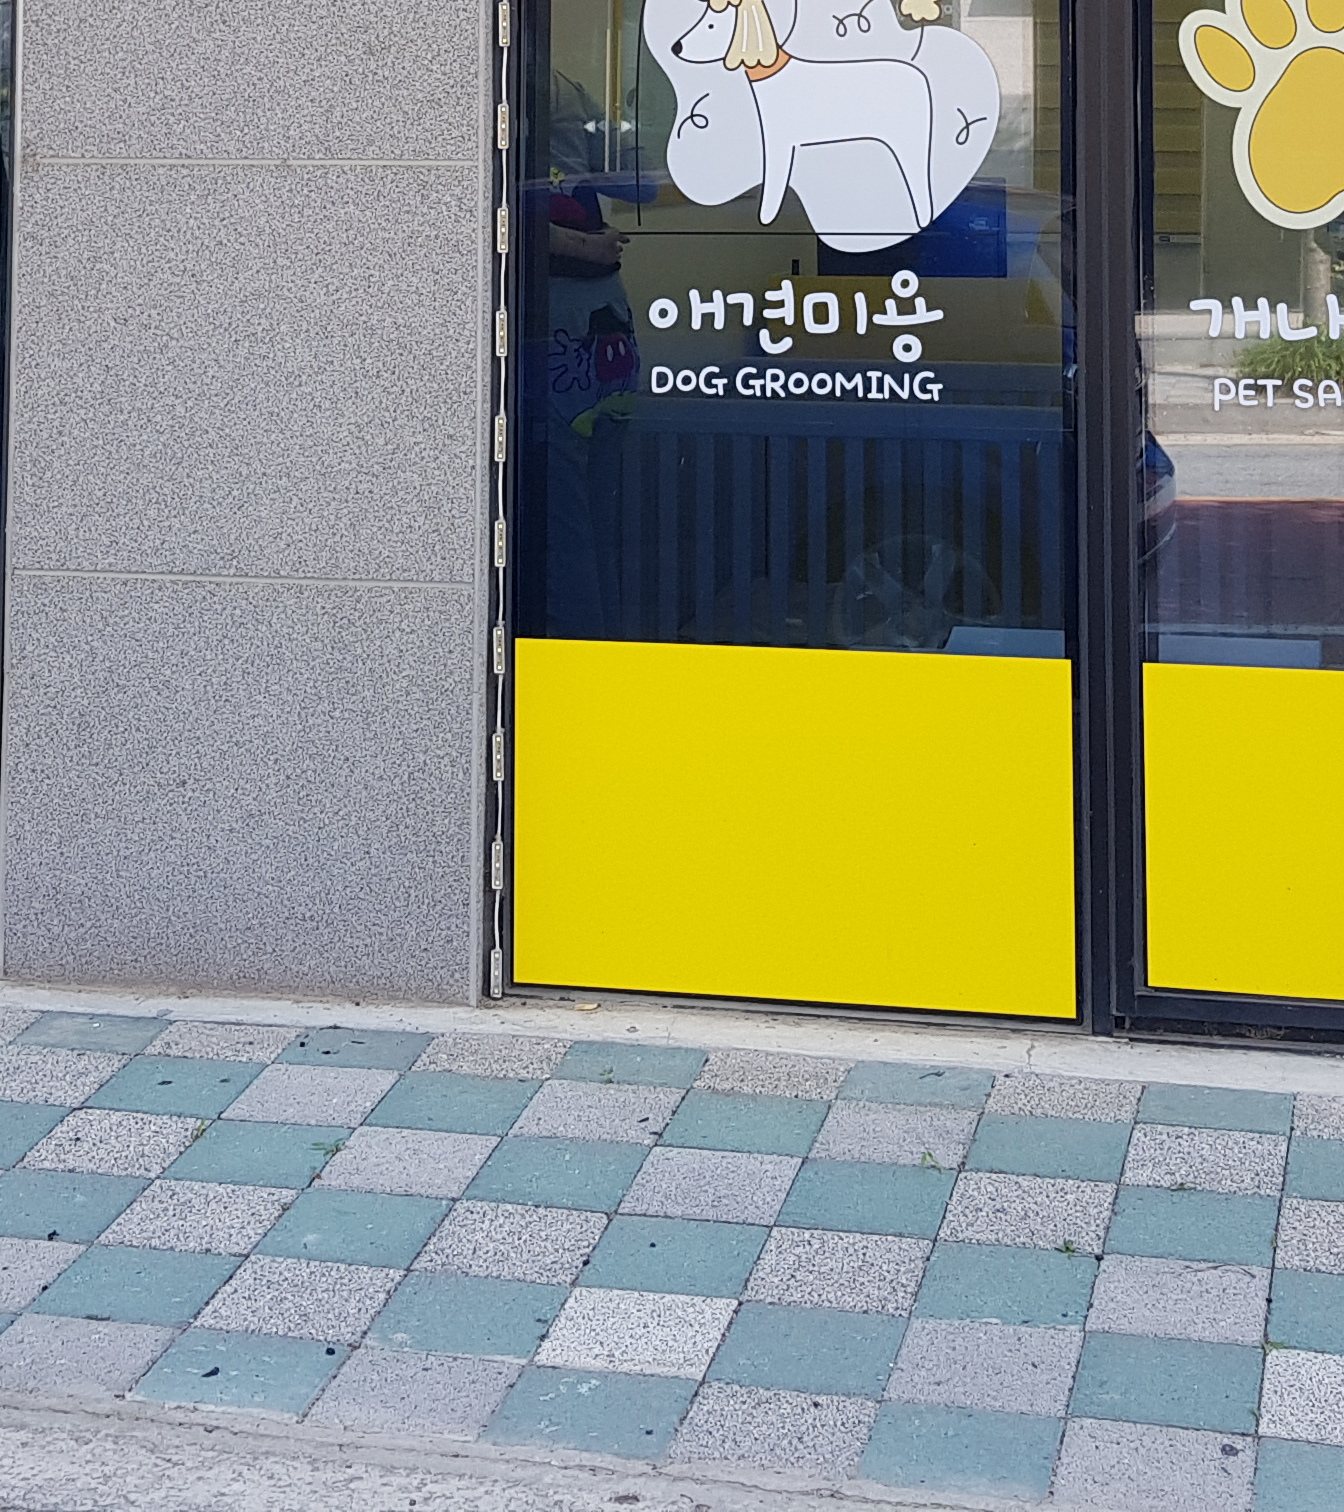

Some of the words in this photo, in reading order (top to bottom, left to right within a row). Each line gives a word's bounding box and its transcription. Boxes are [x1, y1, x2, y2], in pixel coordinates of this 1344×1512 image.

[648, 269, 945, 363] 애견미용
[650, 365, 728, 397] DOG
[735, 367, 943, 402] GROOMING
[1212, 377, 1283, 412] PET
